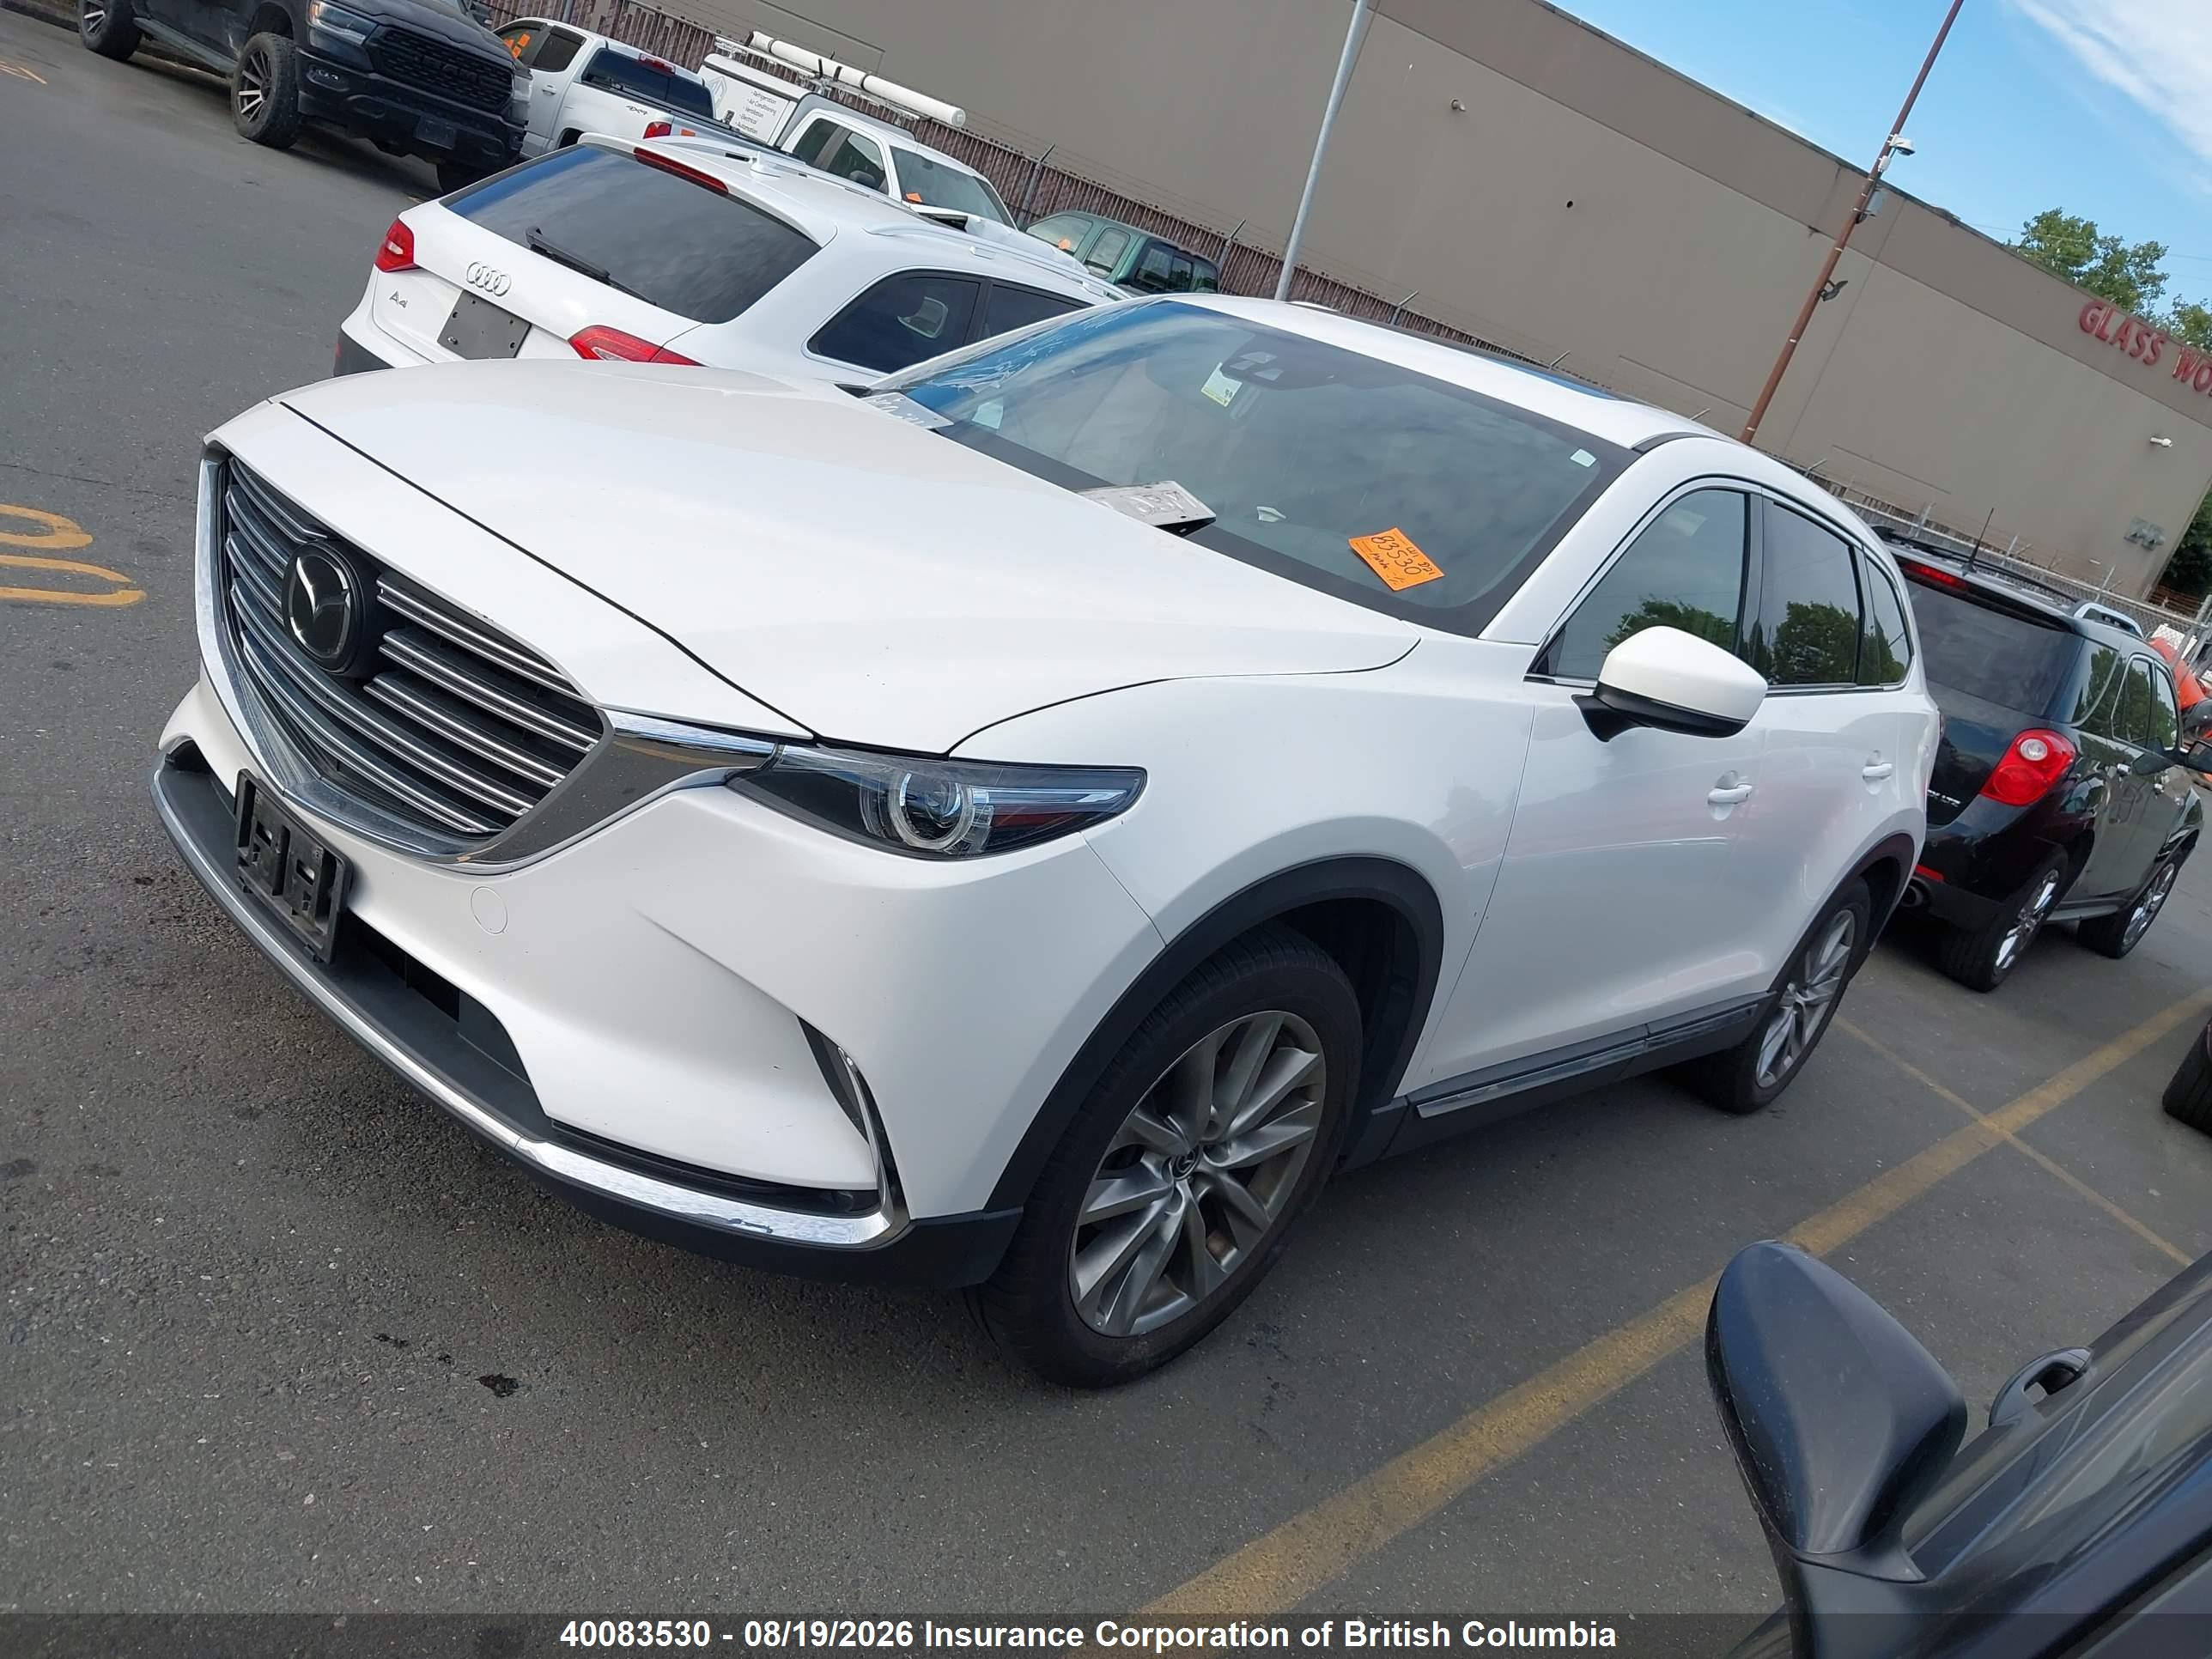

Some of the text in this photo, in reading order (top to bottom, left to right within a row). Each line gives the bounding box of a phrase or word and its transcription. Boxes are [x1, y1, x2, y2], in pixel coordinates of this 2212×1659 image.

[753, 90, 776, 104] Refrigeration
[745, 107, 764, 118] Ventilation
[755, 100, 776, 116] Conditioning
[740, 113, 757, 125] Electrical
[737, 122, 757, 133] Automation
[389, 290, 408, 308] A4
[2079, 301, 2212, 397] GLASS WO
[1370, 535, 1422, 575] 83530
